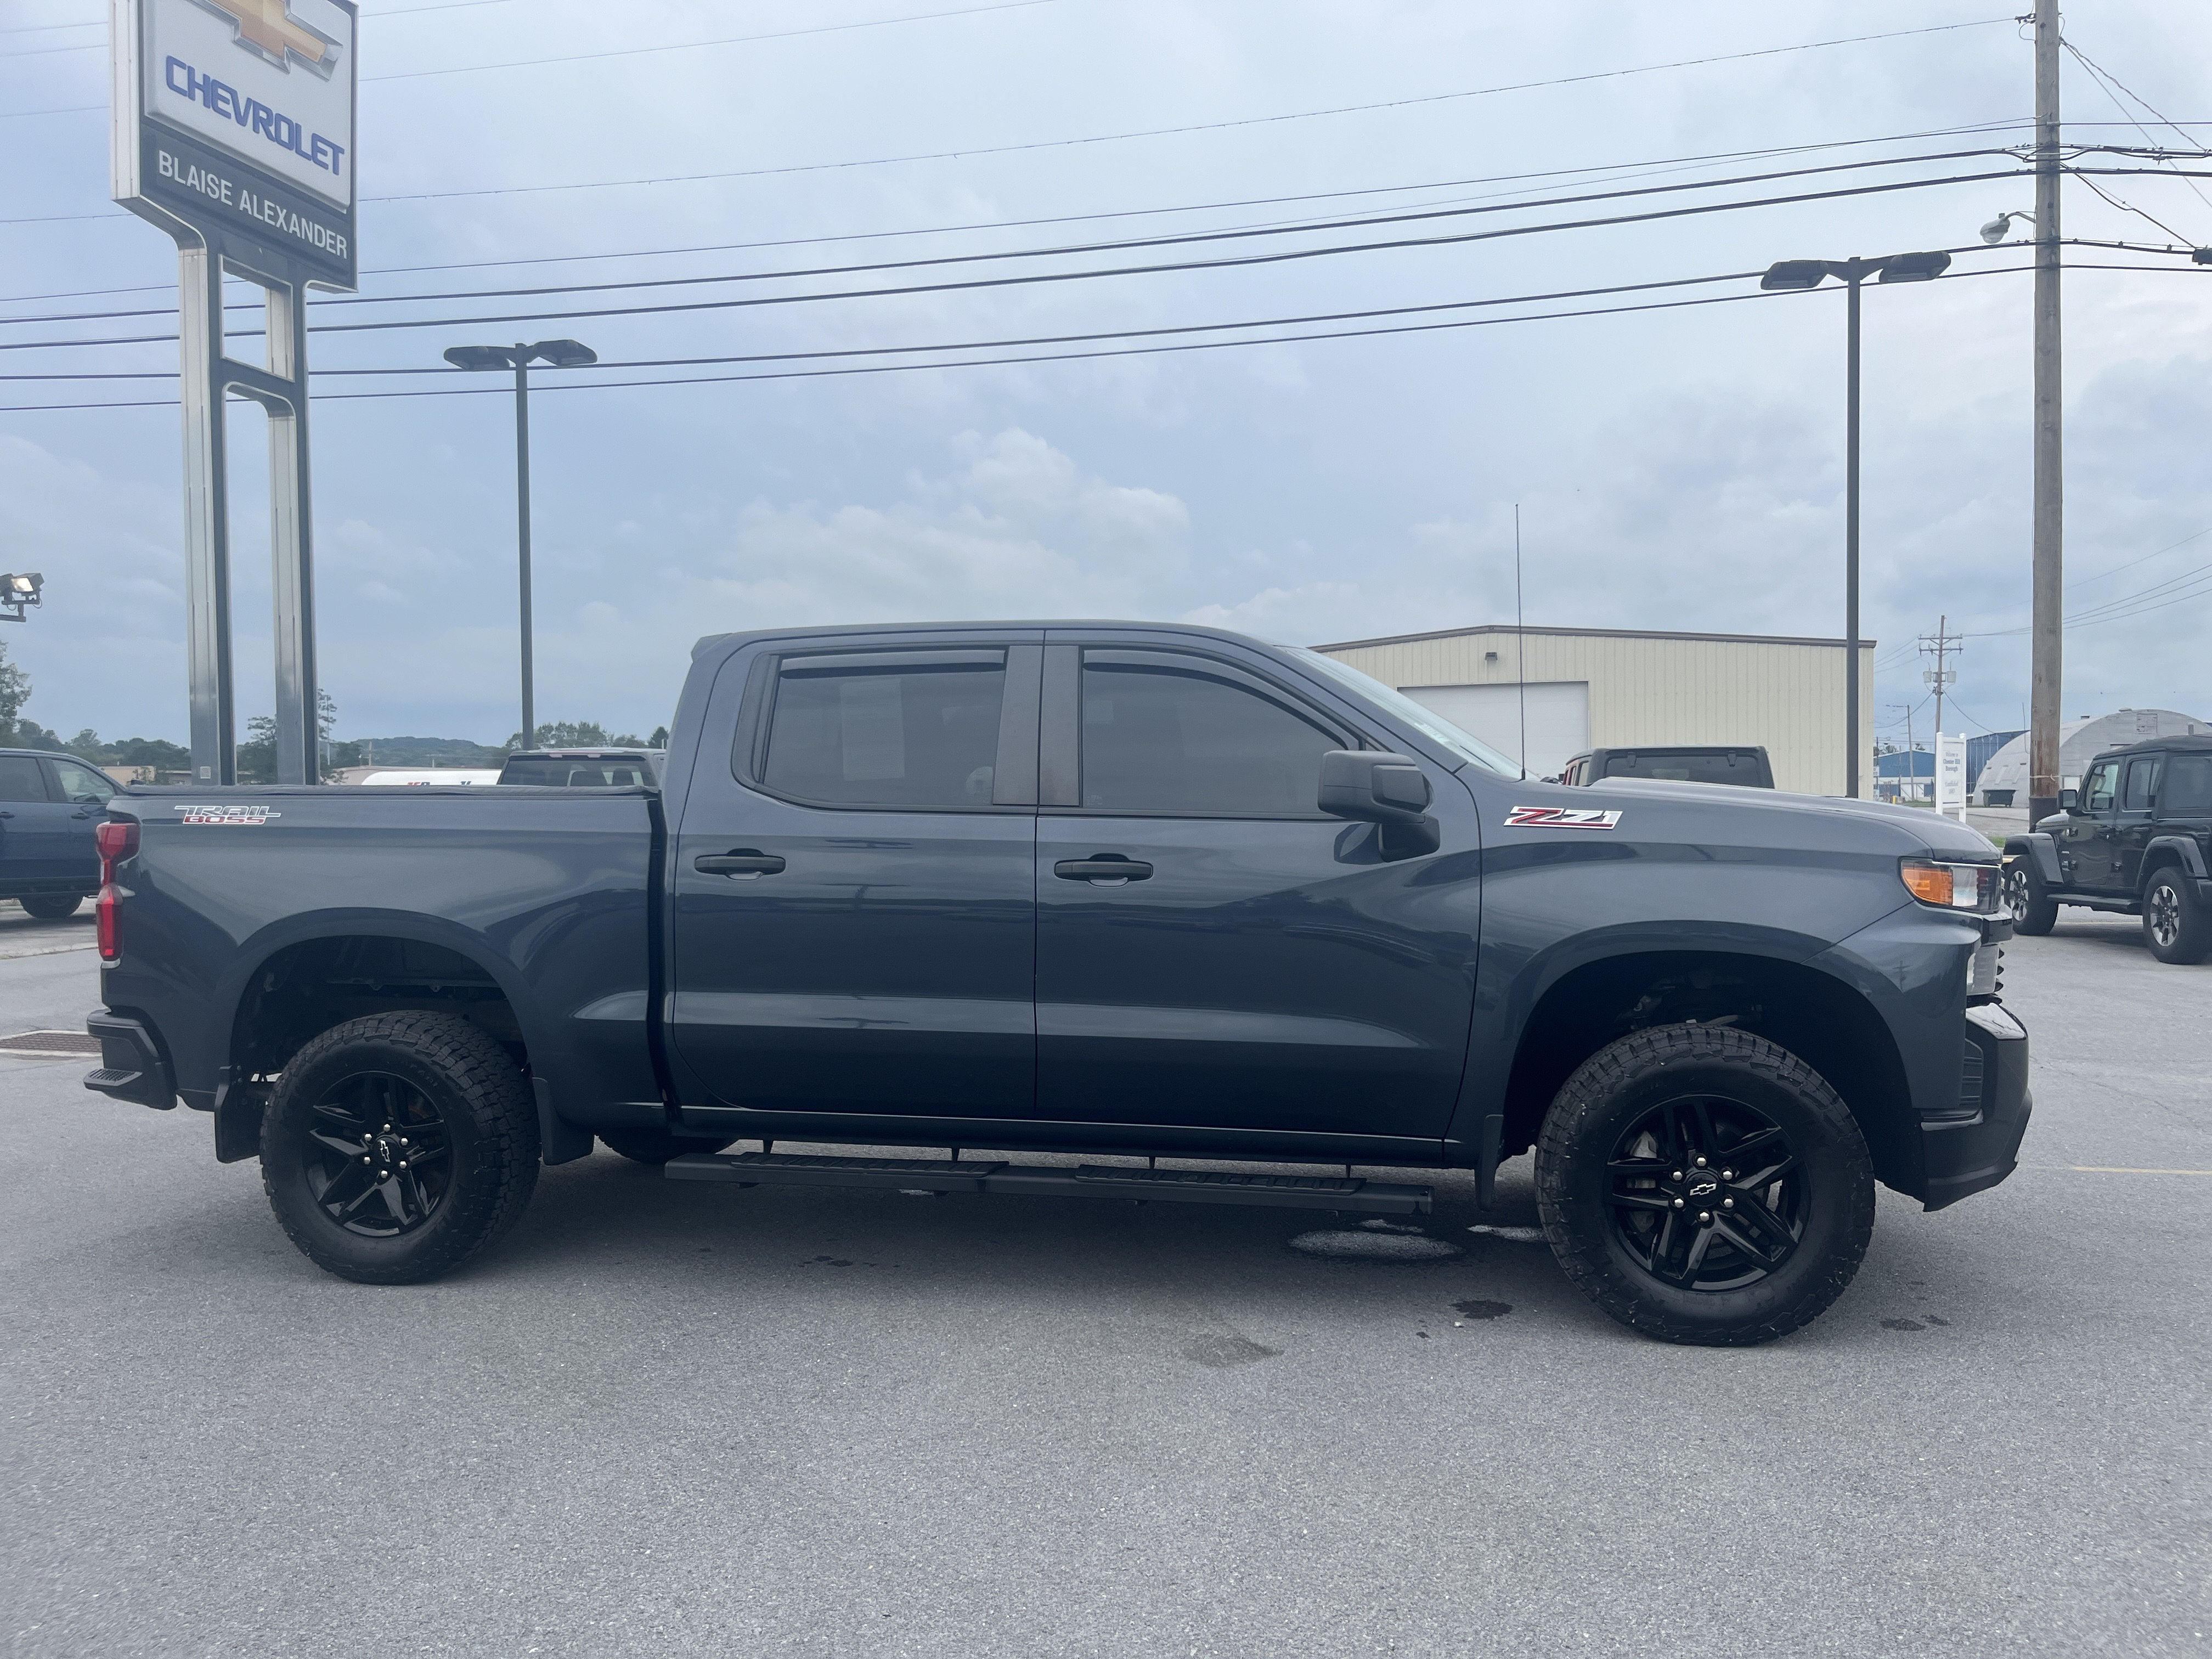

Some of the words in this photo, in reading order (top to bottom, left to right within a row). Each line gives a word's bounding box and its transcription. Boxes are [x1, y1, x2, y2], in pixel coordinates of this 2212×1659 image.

[166, 55, 345, 176] CHEVROLET
[159, 150, 233, 207] BLAISE
[239, 189, 347, 259] ALEXANDER
[174, 805, 282, 817] TRAIL
[182, 815, 267, 825] BOSS
[1503, 806, 1623, 830] Z71
